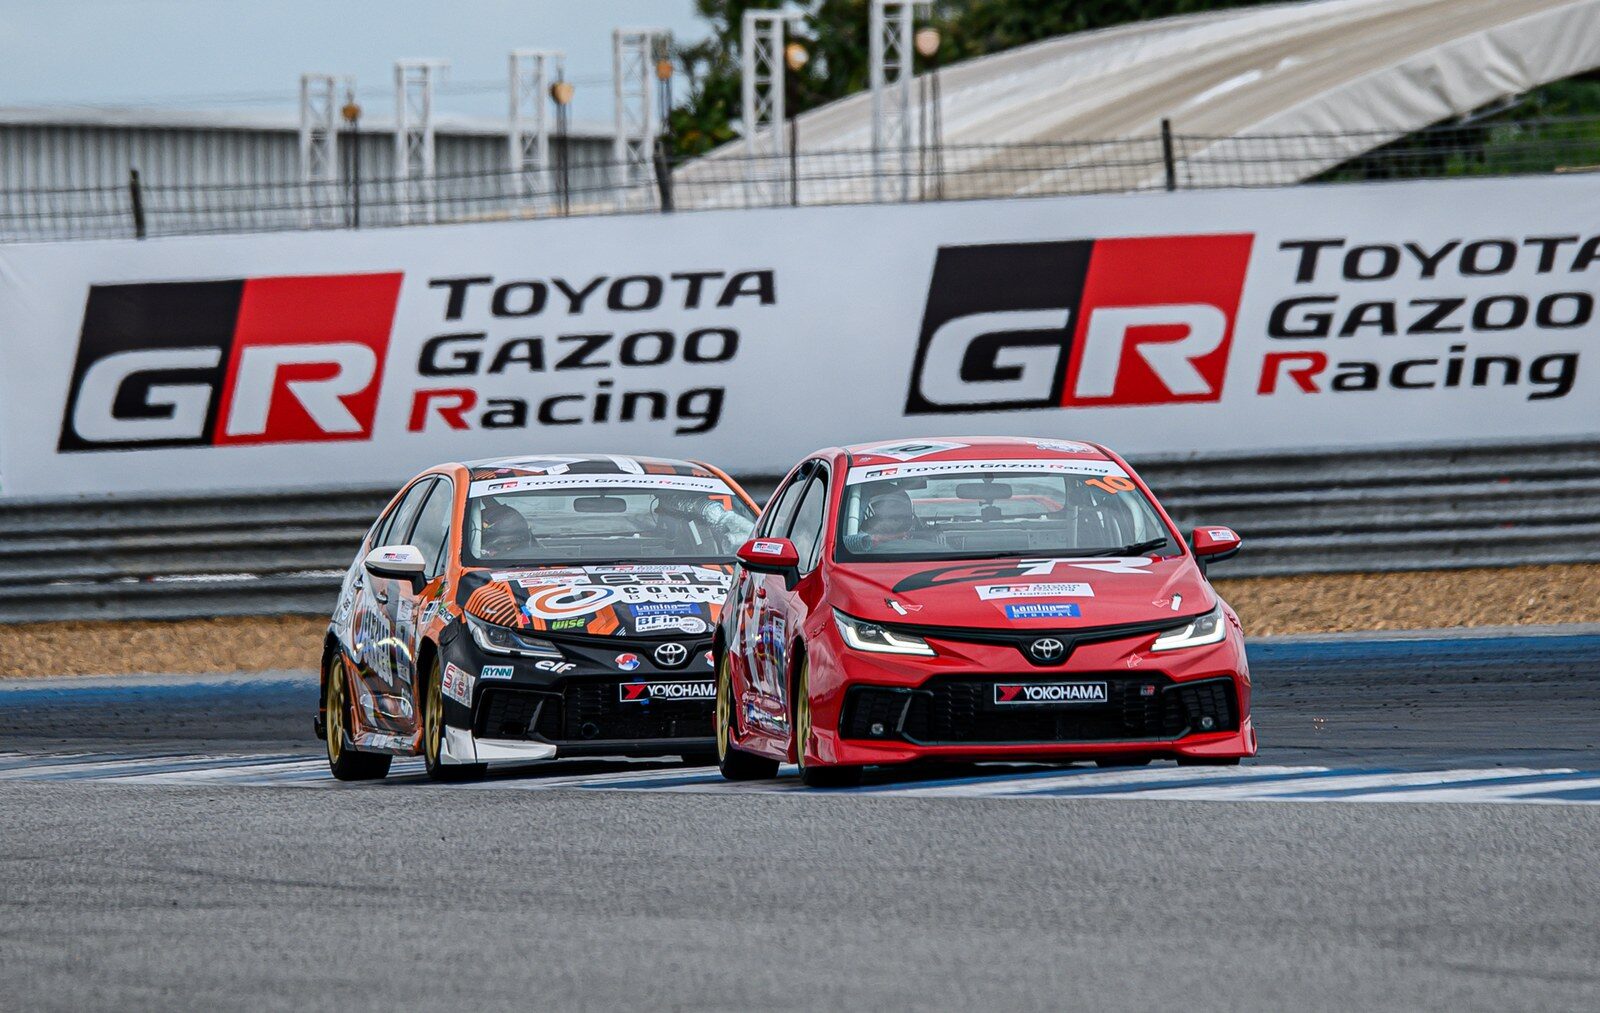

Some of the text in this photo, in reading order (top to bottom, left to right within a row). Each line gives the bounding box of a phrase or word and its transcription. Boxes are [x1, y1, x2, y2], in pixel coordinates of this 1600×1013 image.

[428, 270, 777, 321] TOYOTA
[1267, 291, 1595, 341] GAZOO
[417, 328, 740, 377] GAZOO
[920, 302, 1227, 406] GR
[1257, 345, 1580, 401] Racing
[73, 341, 378, 443] GR
[407, 380, 727, 436] Racing
[903, 463, 975, 474] TOYOTA
[1049, 464, 1109, 474] Racing
[523, 479, 590, 487] TOYOTA
[658, 480, 714, 489] Racing
[1085, 476, 1136, 494] 10
[892, 557, 1154, 593] GR
[552, 618, 585, 630] WISE
[638, 615, 679, 626] BFin
[482, 667, 513, 677] RYNNI
[535, 660, 576, 674] elf
[1023, 685, 1104, 699] YOKOHAMA
